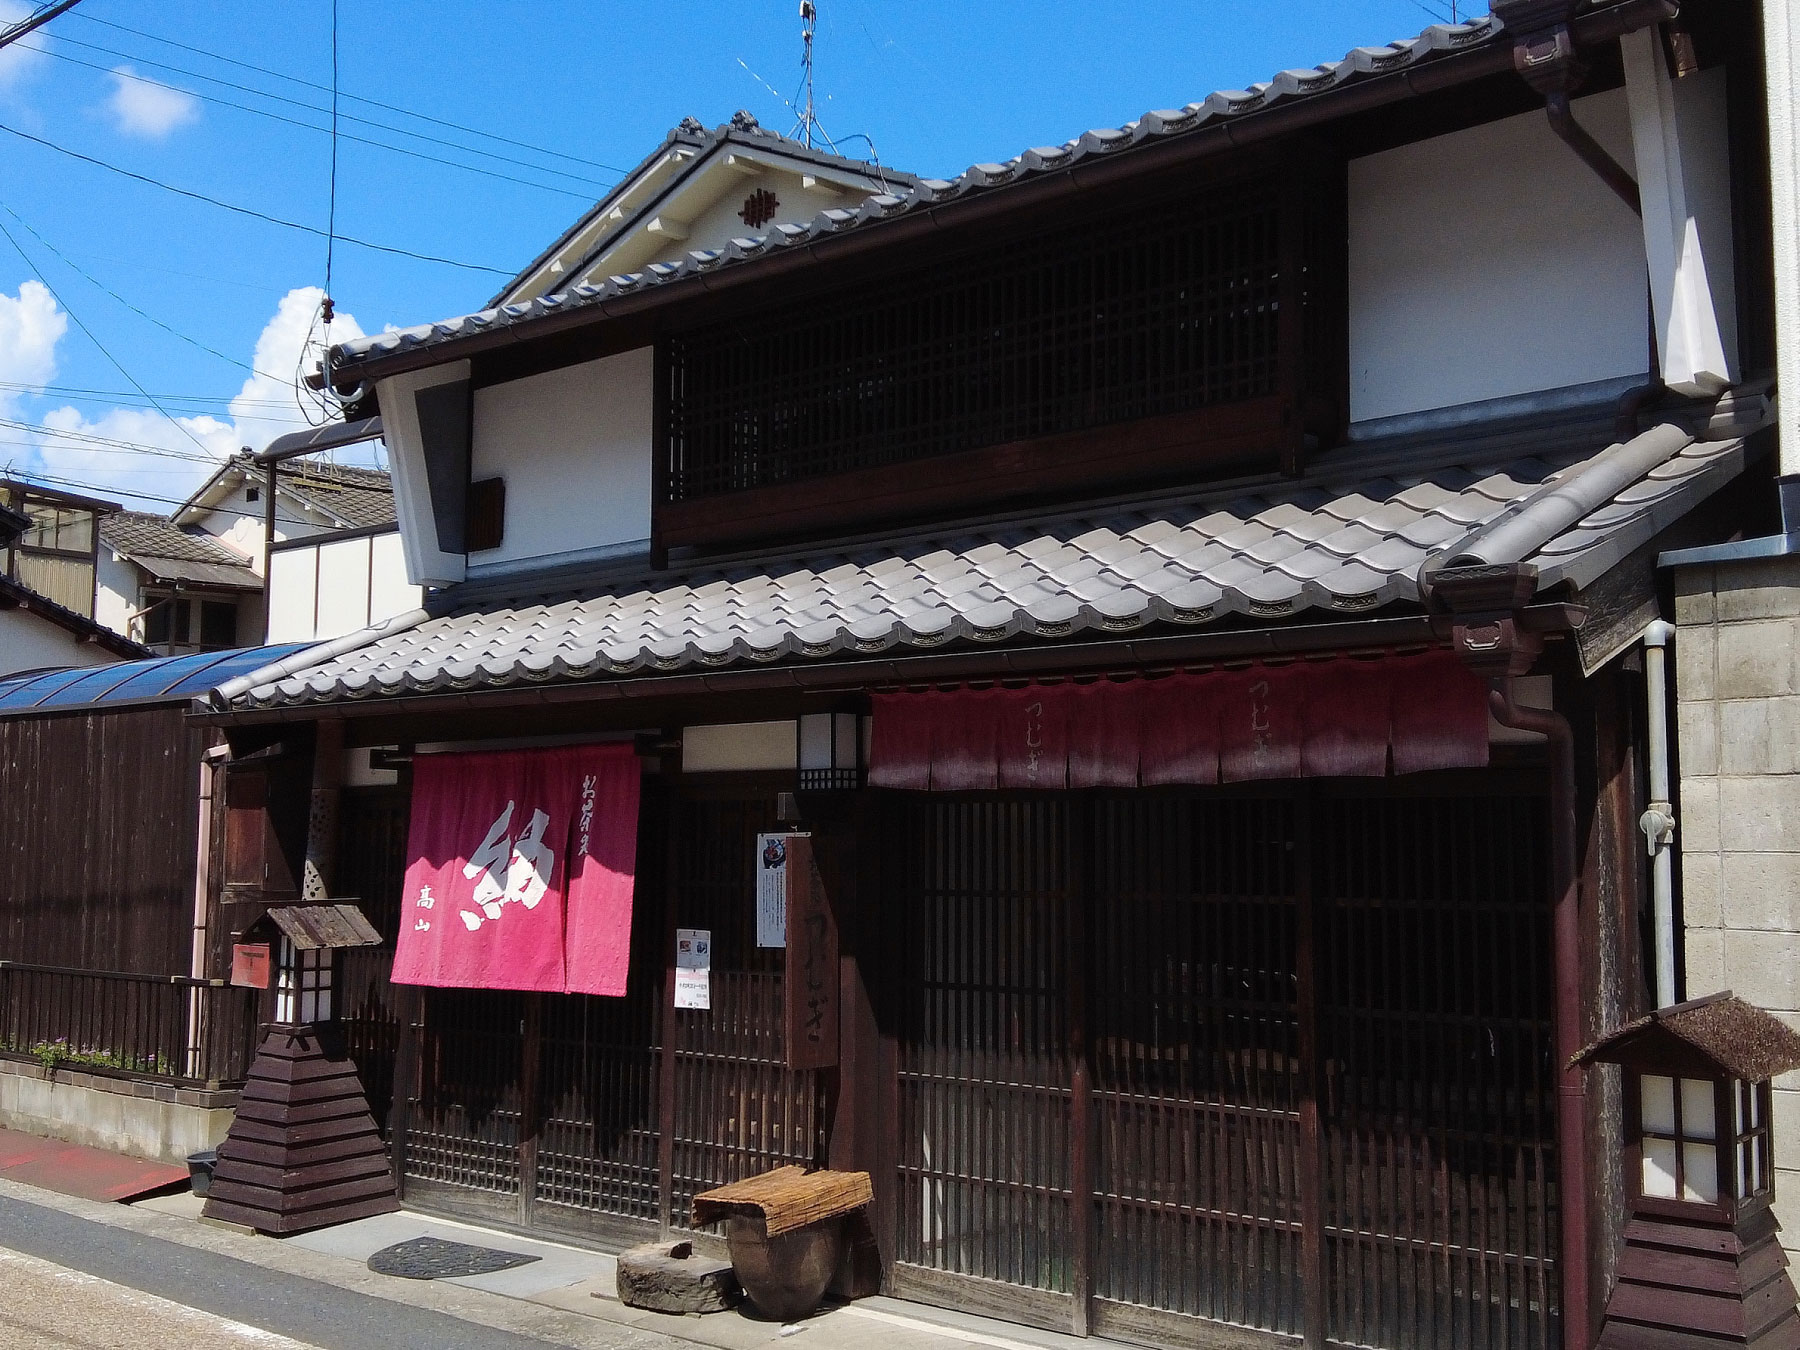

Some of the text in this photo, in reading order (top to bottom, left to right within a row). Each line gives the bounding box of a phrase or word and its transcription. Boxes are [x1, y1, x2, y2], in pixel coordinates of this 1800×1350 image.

[1024, 701, 1044, 781] つむぎ
[414, 885, 435, 932] 高山
